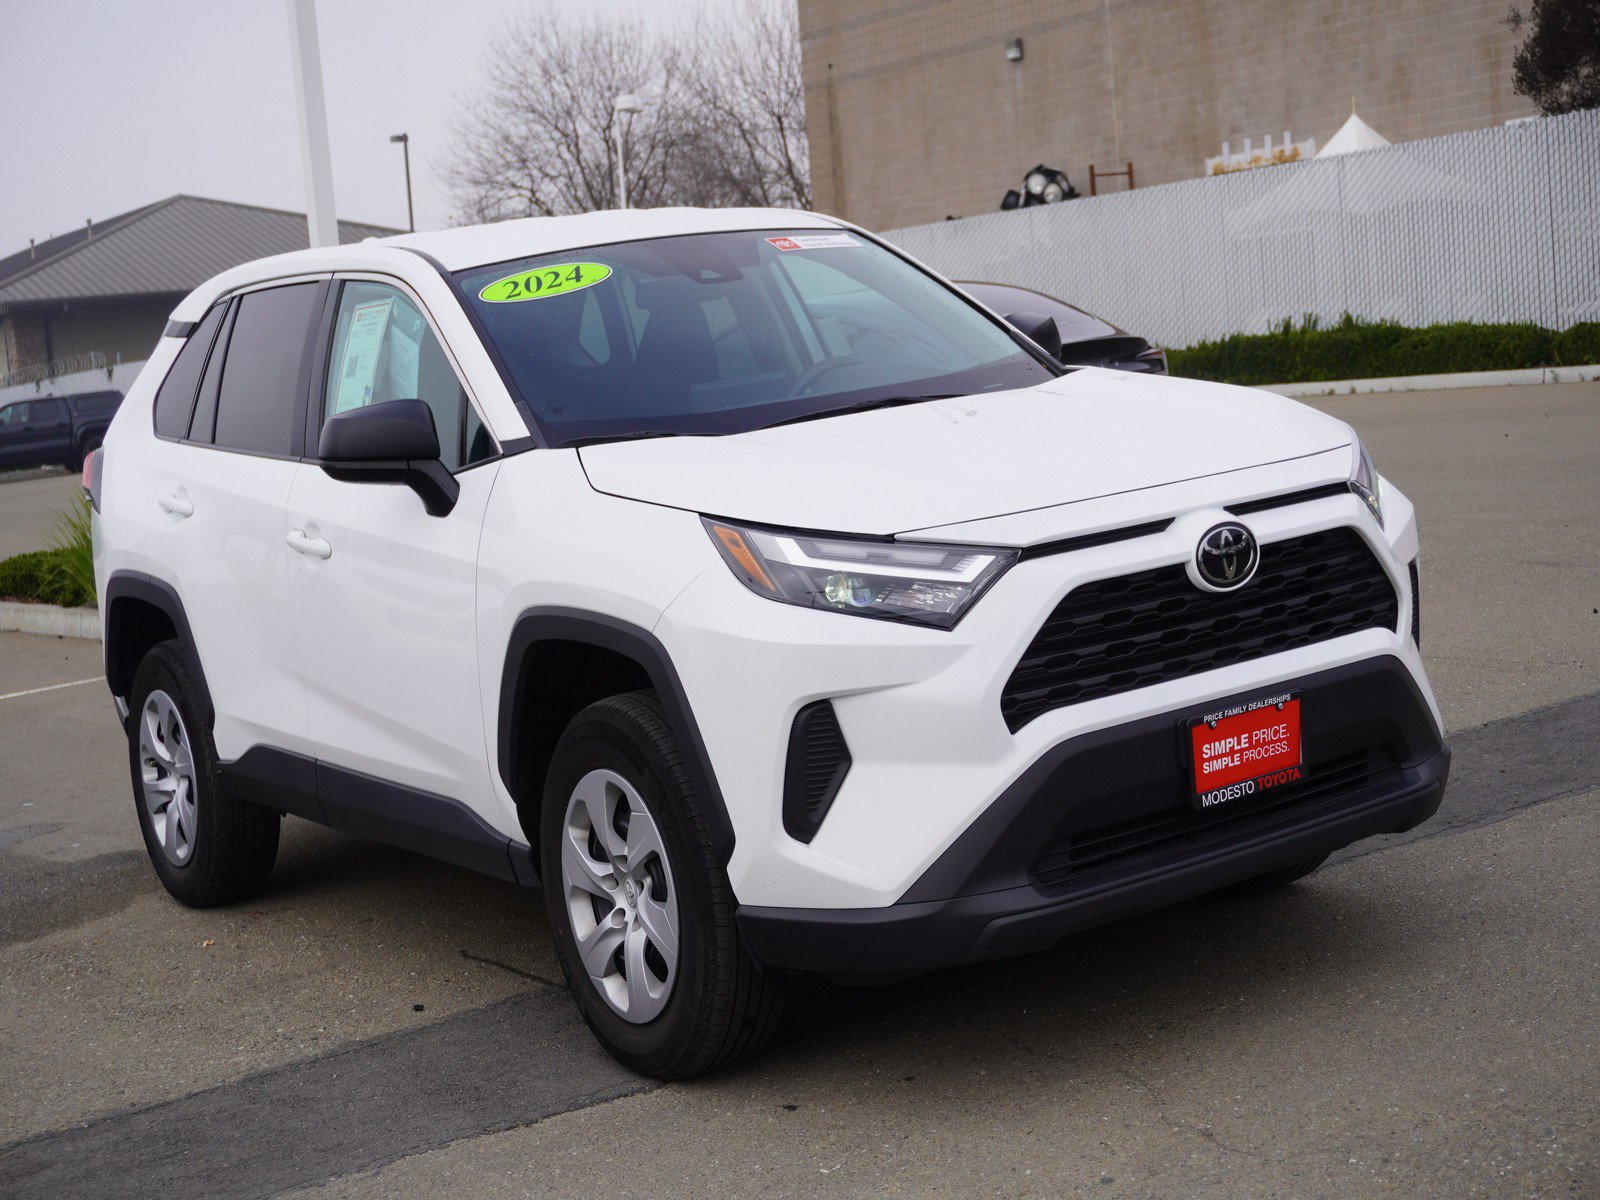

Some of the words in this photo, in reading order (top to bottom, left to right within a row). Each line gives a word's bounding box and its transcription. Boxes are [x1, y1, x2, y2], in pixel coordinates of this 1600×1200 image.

[502, 265, 584, 300] 2024
[1203, 711, 1223, 723] PRICE
[1224, 705, 1247, 717] FAMILY
[1248, 693, 1291, 711] DEALERSHIPS
[1202, 733, 1249, 759] SIMPLE
[1252, 723, 1290, 745] PRICE.
[1203, 753, 1241, 774] SIMPLE
[1243, 741, 1290, 763] PROCESS.
[1201, 780, 1255, 808] MODESTO
[1257, 768, 1301, 790] TOYOTA
